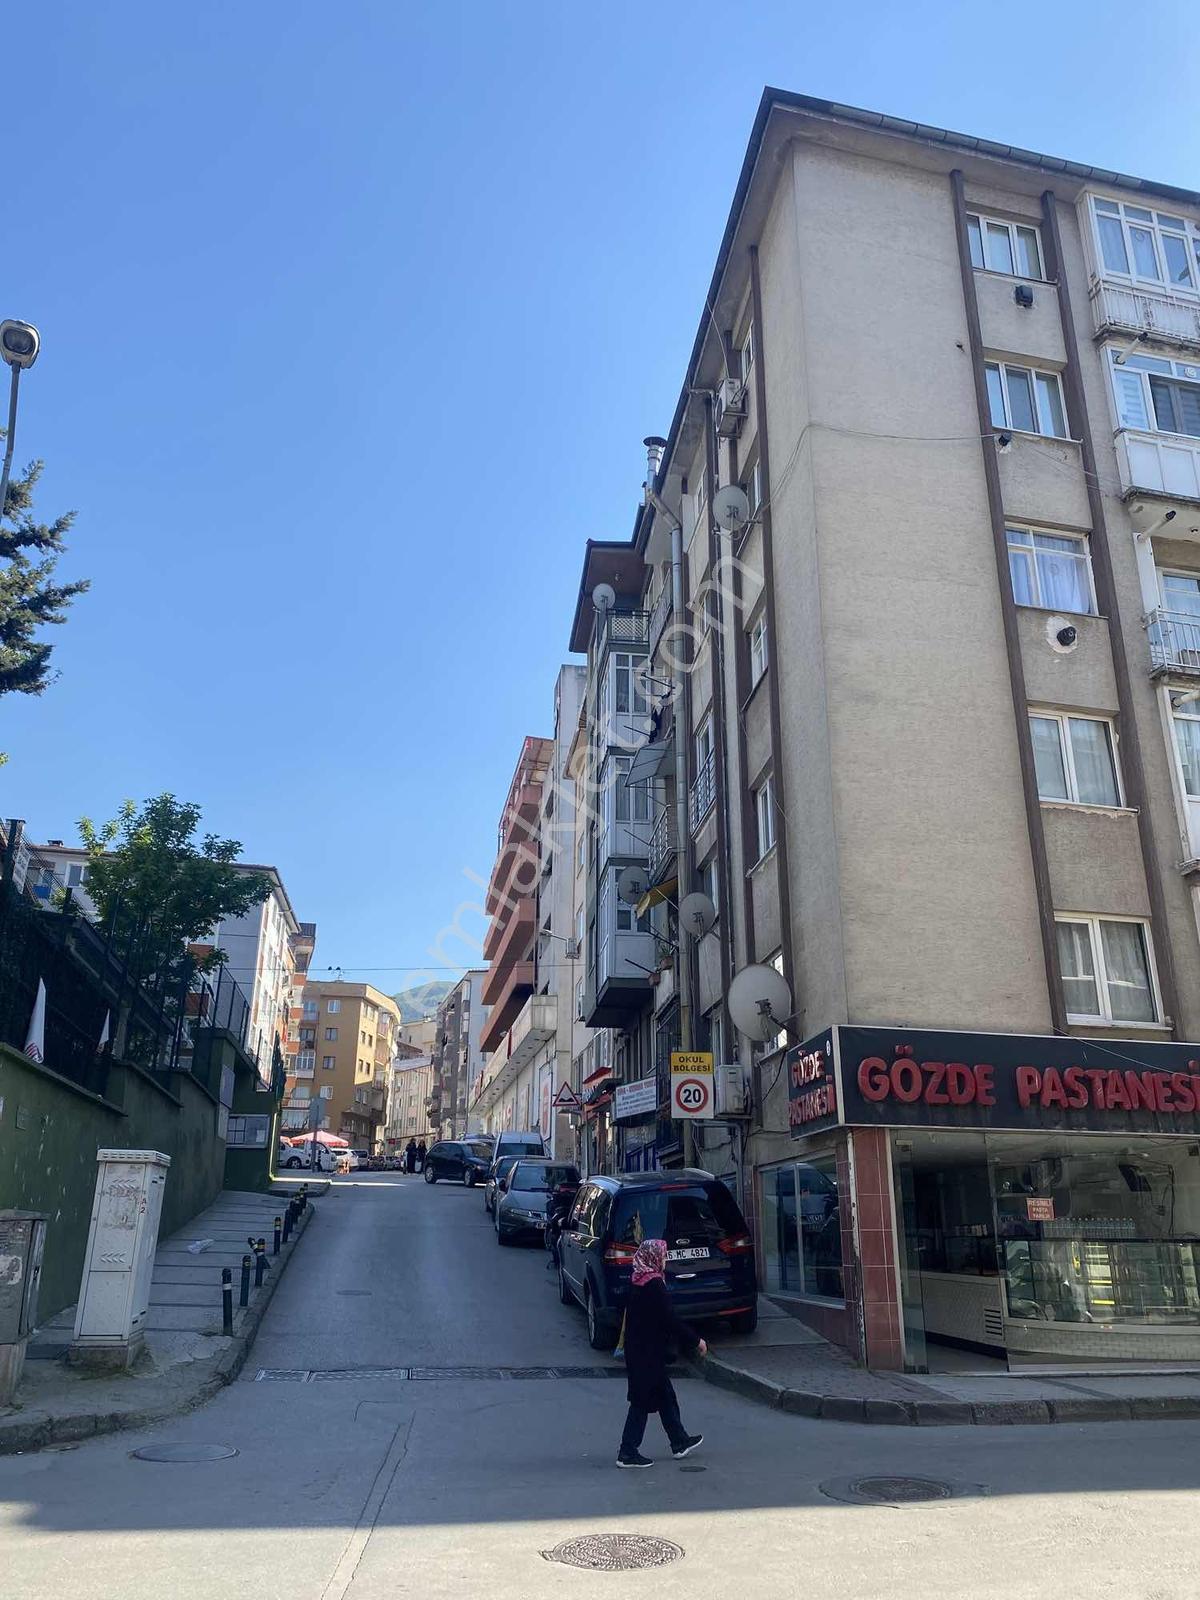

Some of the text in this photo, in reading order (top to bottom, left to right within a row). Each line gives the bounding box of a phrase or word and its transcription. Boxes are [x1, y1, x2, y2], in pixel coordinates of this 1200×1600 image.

[673, 1064, 711, 1072] BÖLGESİ
[791, 1049, 825, 1088] GÖZDE
[857, 1045, 997, 1106] GÖZDE
[683, 1088, 701, 1103] 20
[789, 1075, 836, 1125] PASTANESİ
[676, 1249, 687, 1259] MC
[690, 1248, 709, 1257] 4821
